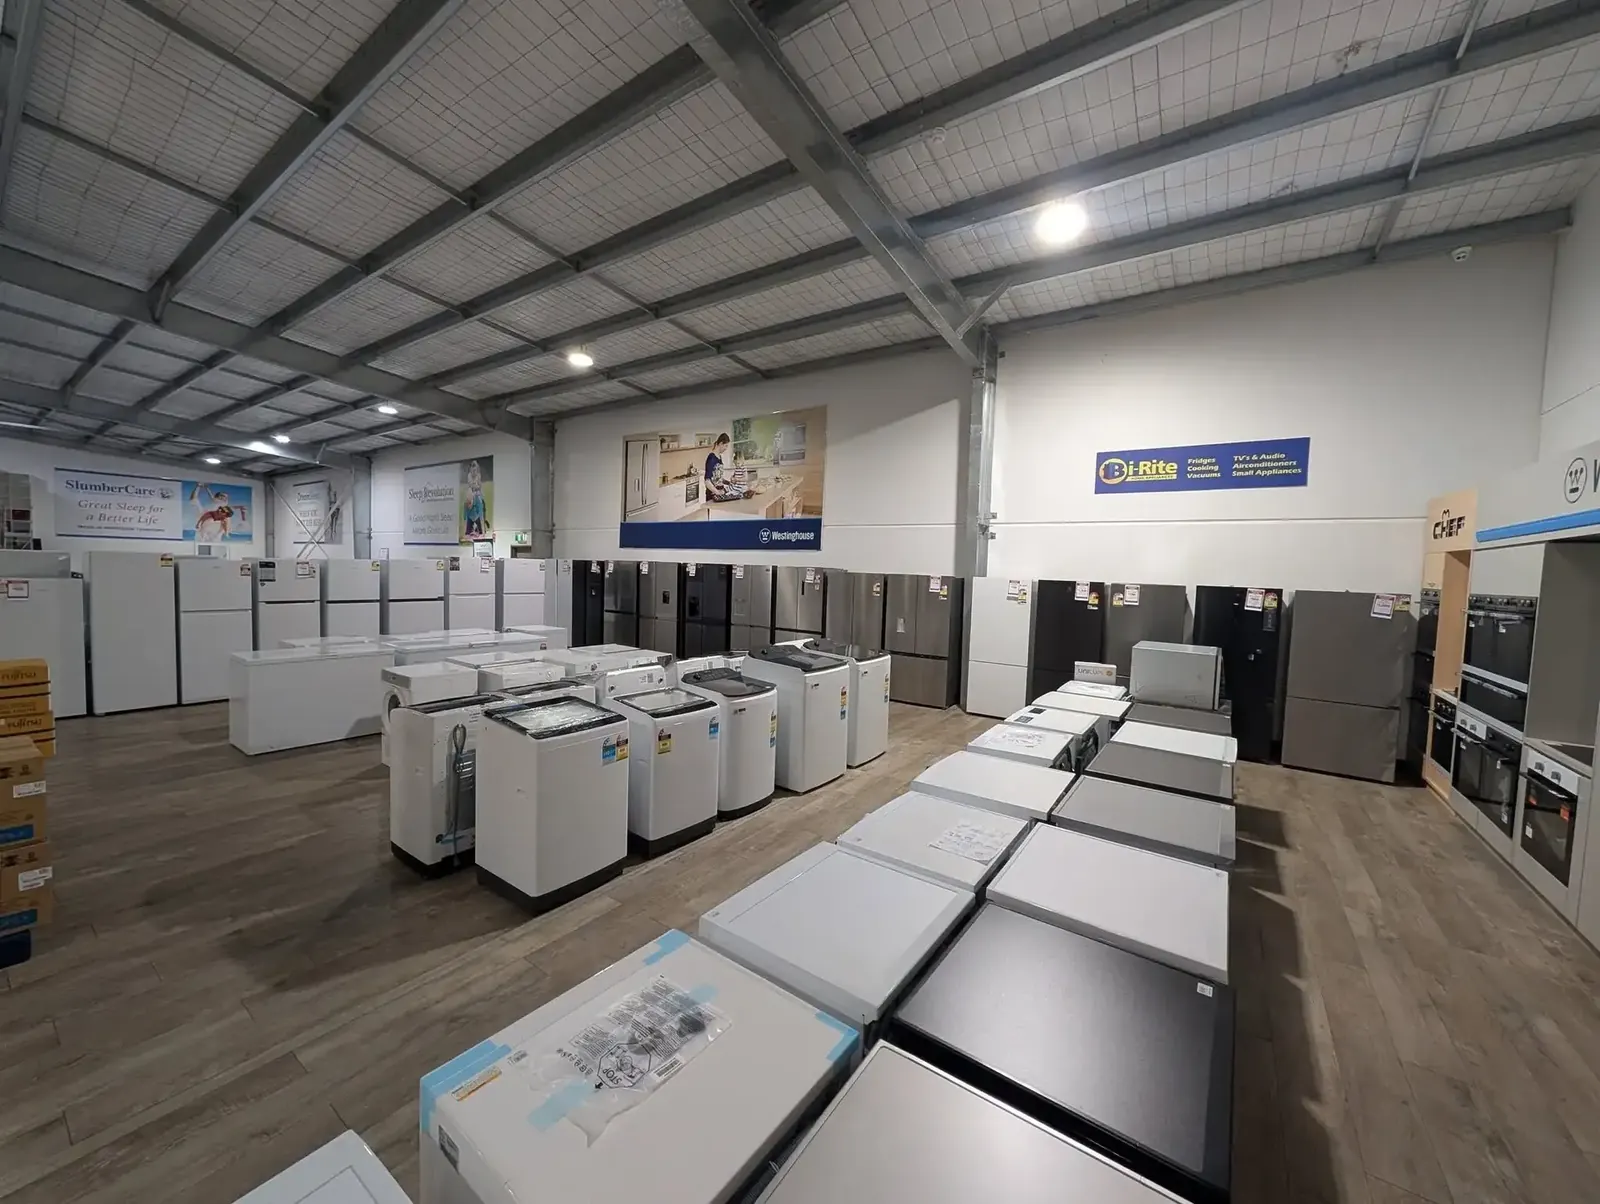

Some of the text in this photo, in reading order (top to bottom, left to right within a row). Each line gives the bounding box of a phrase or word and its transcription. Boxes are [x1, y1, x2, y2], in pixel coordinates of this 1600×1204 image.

[1187, 457, 1216, 465] Fridges
[1259, 452, 1286, 460] Audio
[1187, 464, 1219, 473] Cooking
[1232, 460, 1298, 470] Airconditioners
[1255, 468, 1302, 477] Appliances
[65, 480, 156, 495] SlumberCare
[78, 499, 165, 515] Great Sleep for
[98, 513, 135, 524] Better
[138, 515, 159, 526] Life
[1433, 515, 1466, 539] CHEF
[772, 530, 815, 542] Westinghouse
[602, 1067, 623, 1086] STOP
